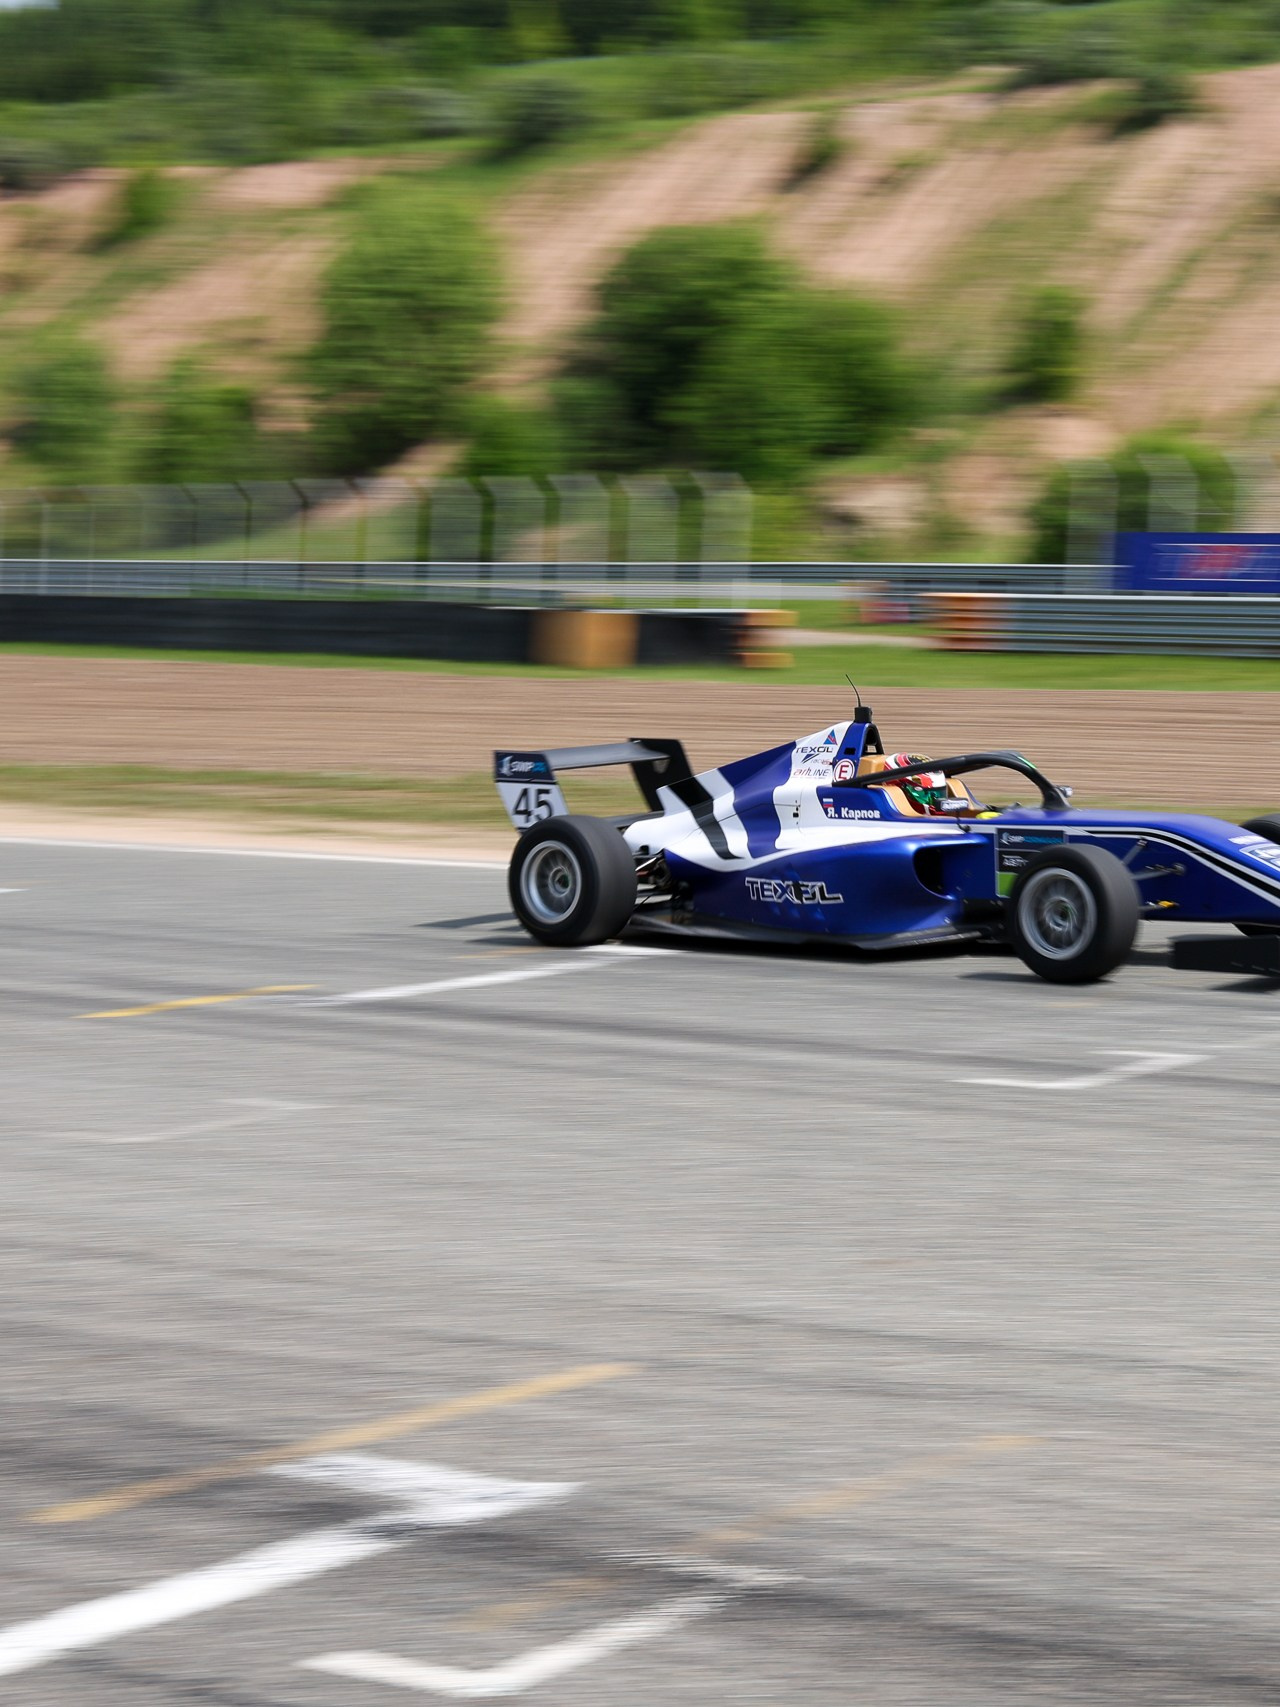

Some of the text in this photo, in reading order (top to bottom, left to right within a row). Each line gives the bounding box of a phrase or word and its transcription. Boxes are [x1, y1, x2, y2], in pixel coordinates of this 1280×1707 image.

[838, 764, 850, 780] E
[512, 787, 553, 824] 45
[827, 808, 881, 820] Я. Карпов
[745, 877, 844, 904] TEXOL
